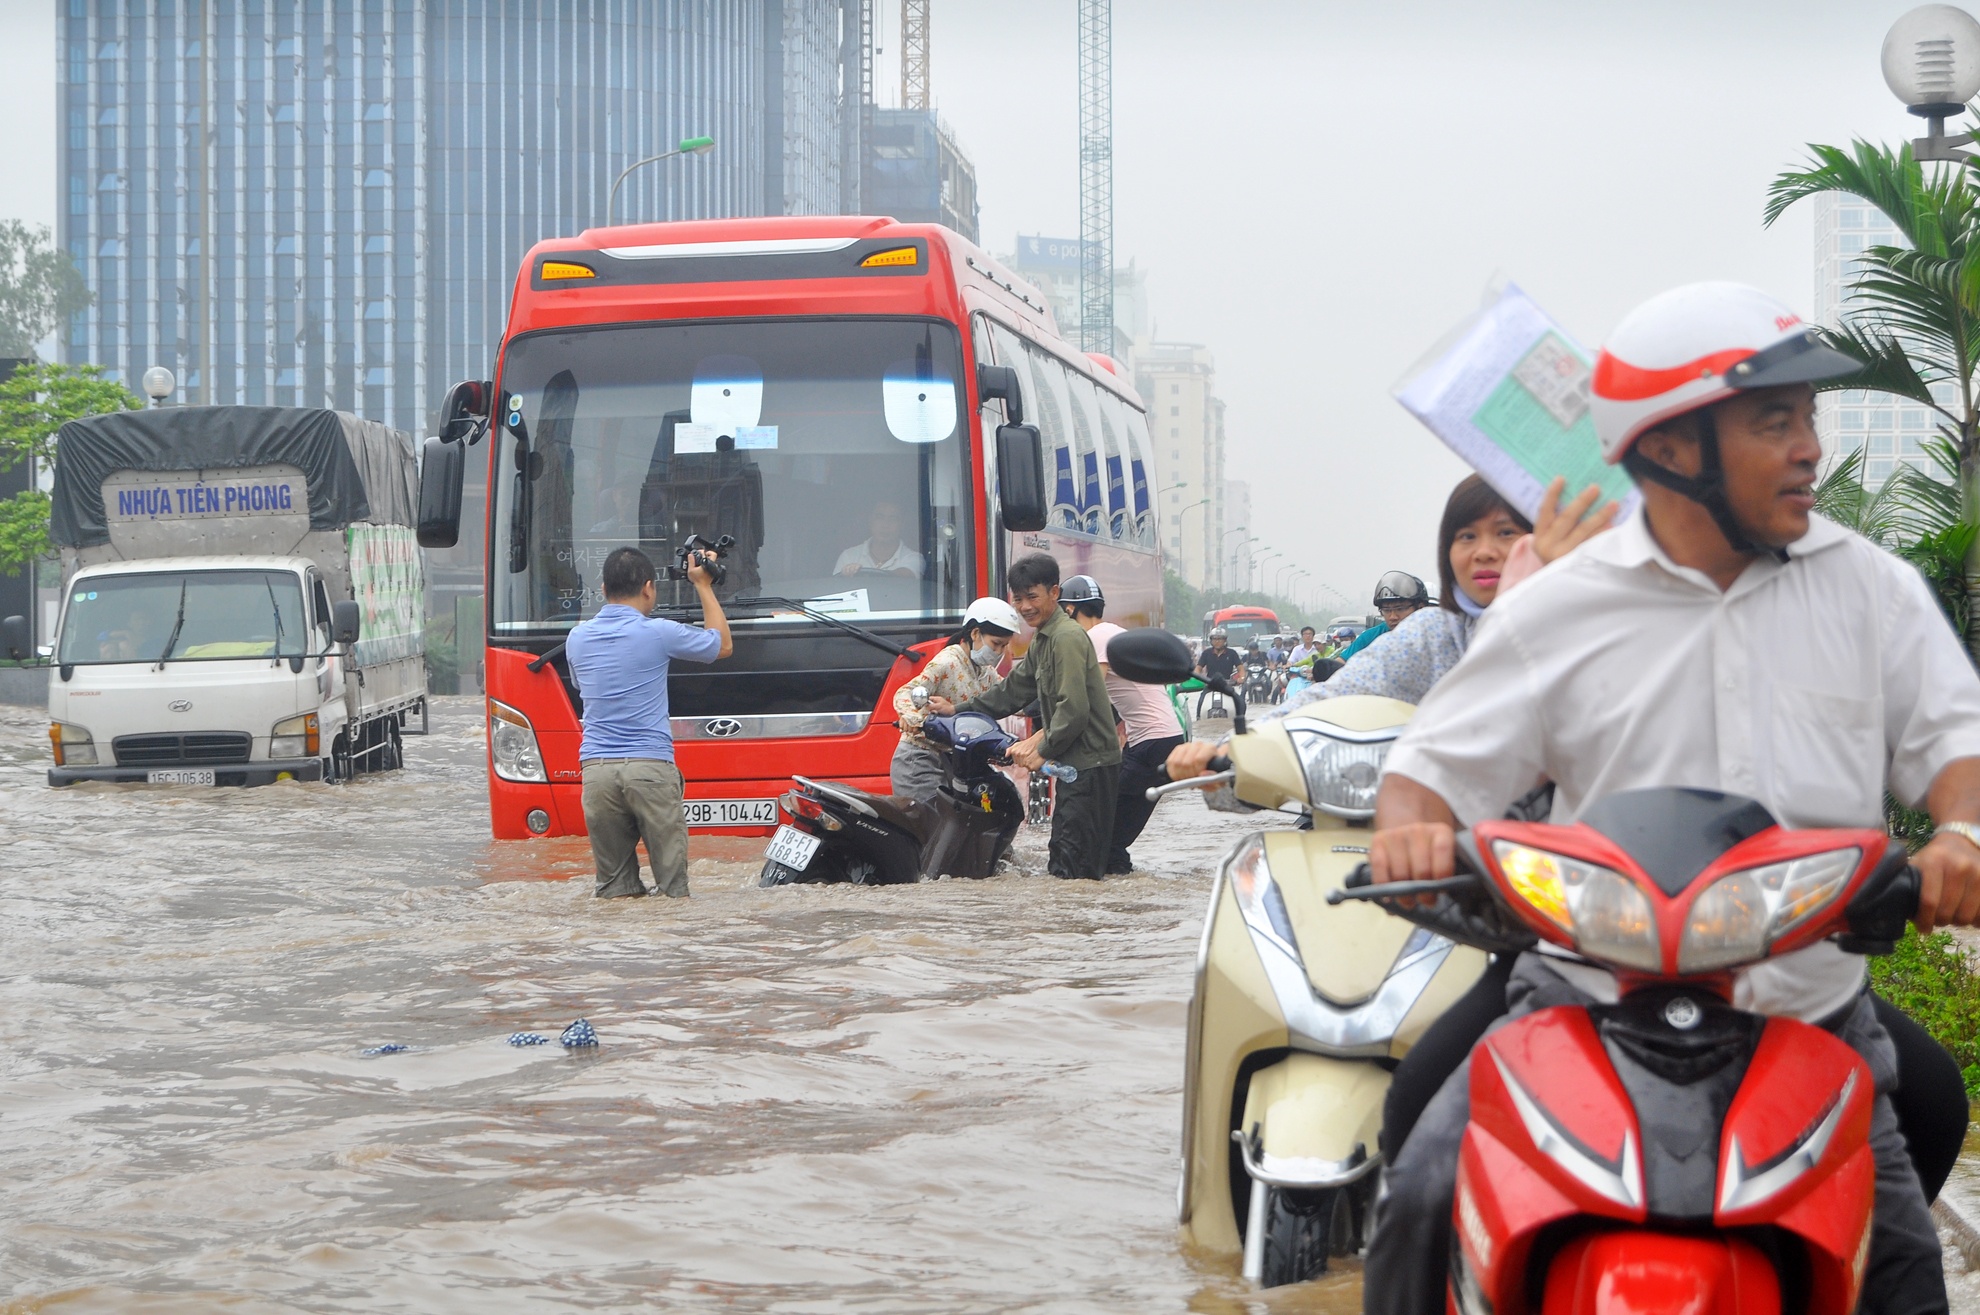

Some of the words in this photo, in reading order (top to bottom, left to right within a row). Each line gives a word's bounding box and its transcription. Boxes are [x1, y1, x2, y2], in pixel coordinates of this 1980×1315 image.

[118, 486, 173, 520] NHỰA
[176, 480, 220, 514] TIỀN
[225, 484, 292, 512] PHONG
[554, 769, 583, 778] UNIV
[684, 803, 773, 823] 29B-104.42
[781, 829, 813, 852] 18-F1
[769, 842, 808, 869] 168.32
